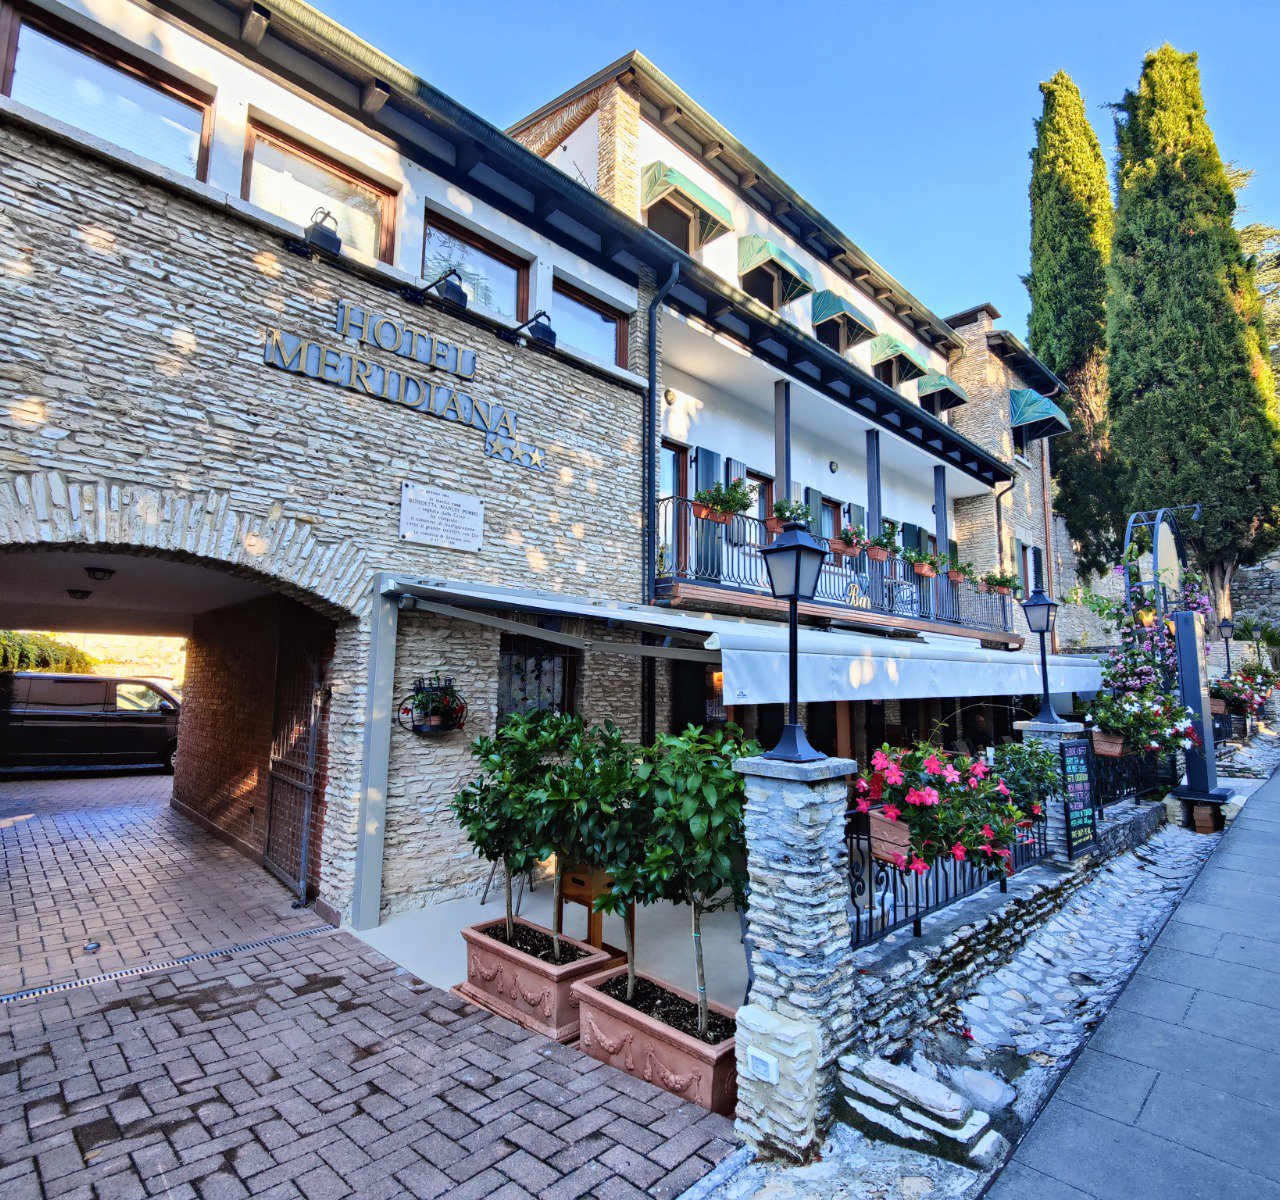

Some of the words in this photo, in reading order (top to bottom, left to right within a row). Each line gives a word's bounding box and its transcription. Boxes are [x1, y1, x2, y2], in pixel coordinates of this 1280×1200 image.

[342, 304, 475, 379] HOTEL
[268, 328, 516, 439] MERIDIANA
[846, 583, 871, 609] Bar
